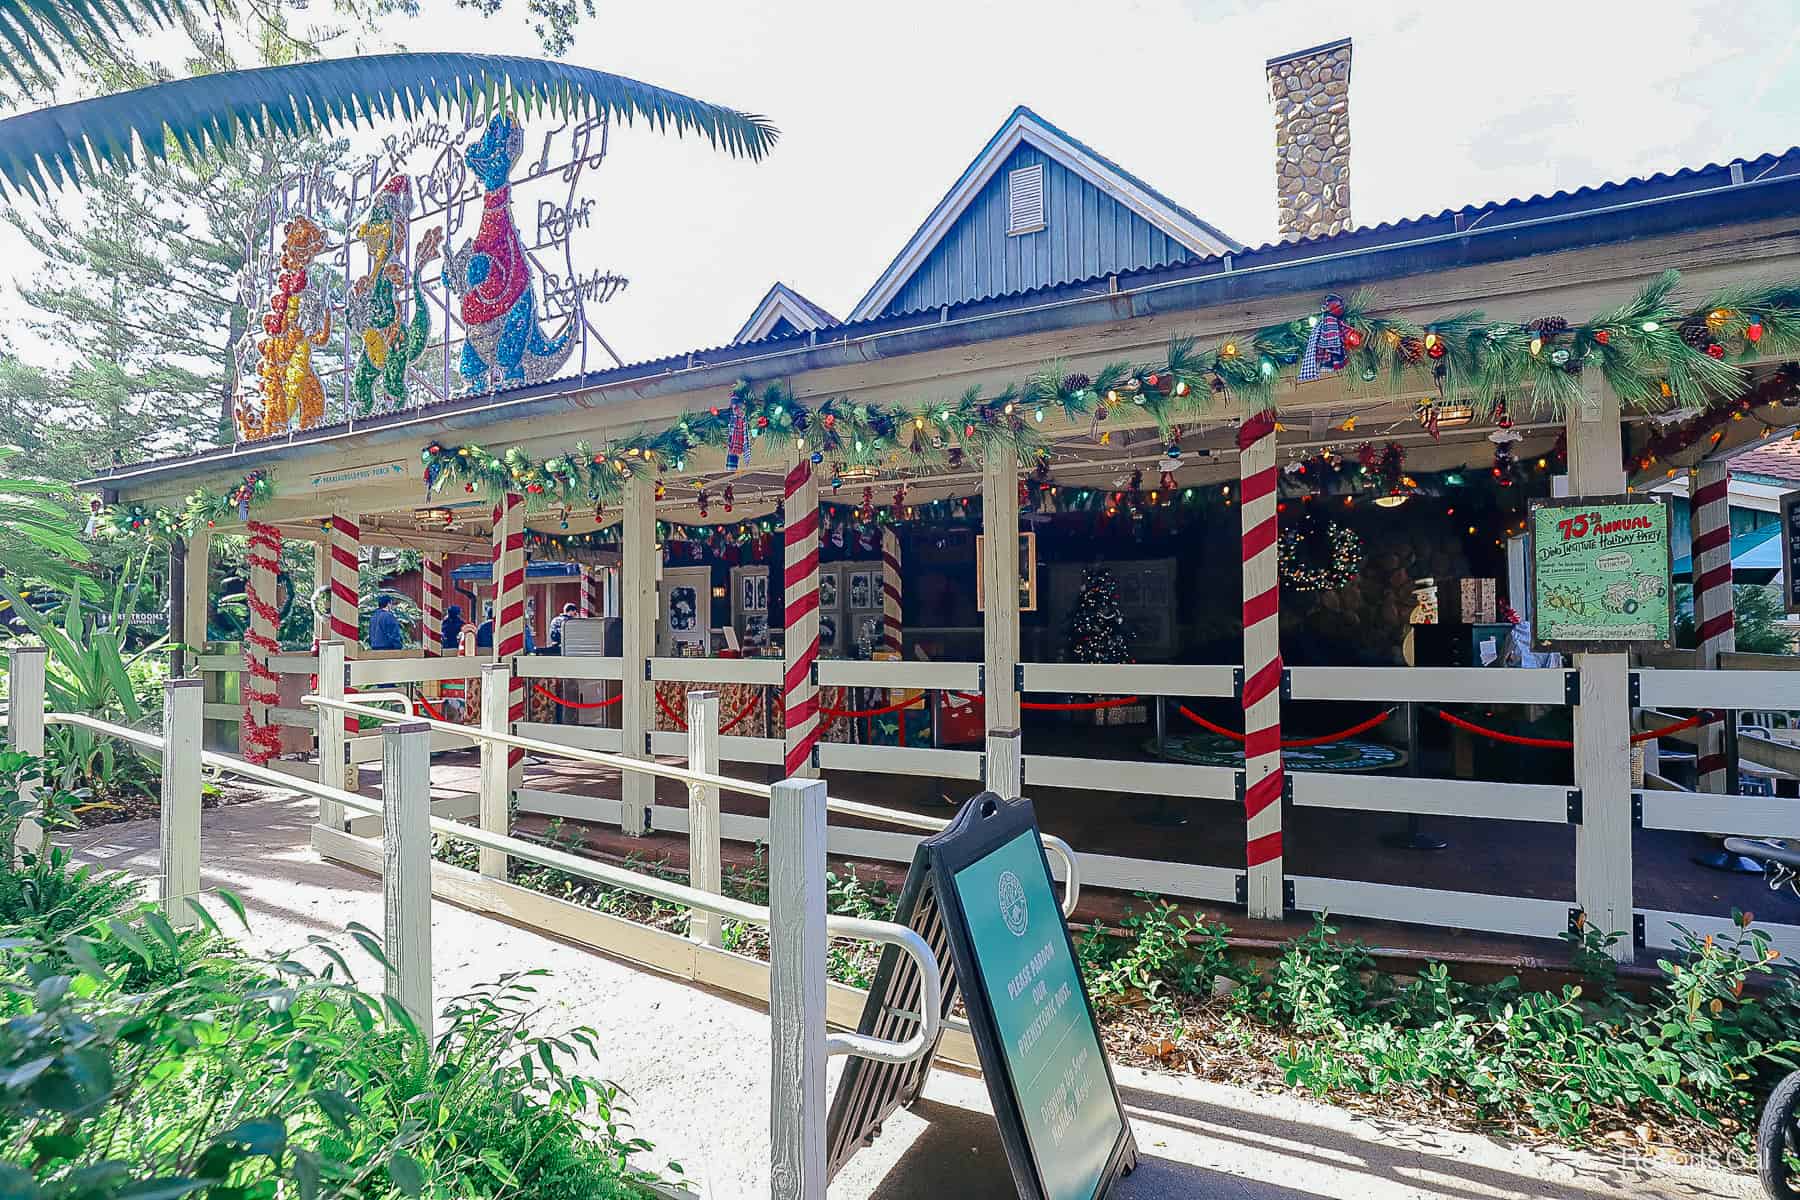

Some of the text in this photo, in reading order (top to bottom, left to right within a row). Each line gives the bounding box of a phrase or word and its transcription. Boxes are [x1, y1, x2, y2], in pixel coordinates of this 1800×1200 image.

[1593, 516, 1653, 536] ANNUAL
[1007, 964, 1033, 1001] PLEASE
[1030, 940, 1056, 977] PARDON
[1032, 980, 1048, 1006] OUR
[1017, 998, 1058, 1057] PREHISTORIC
